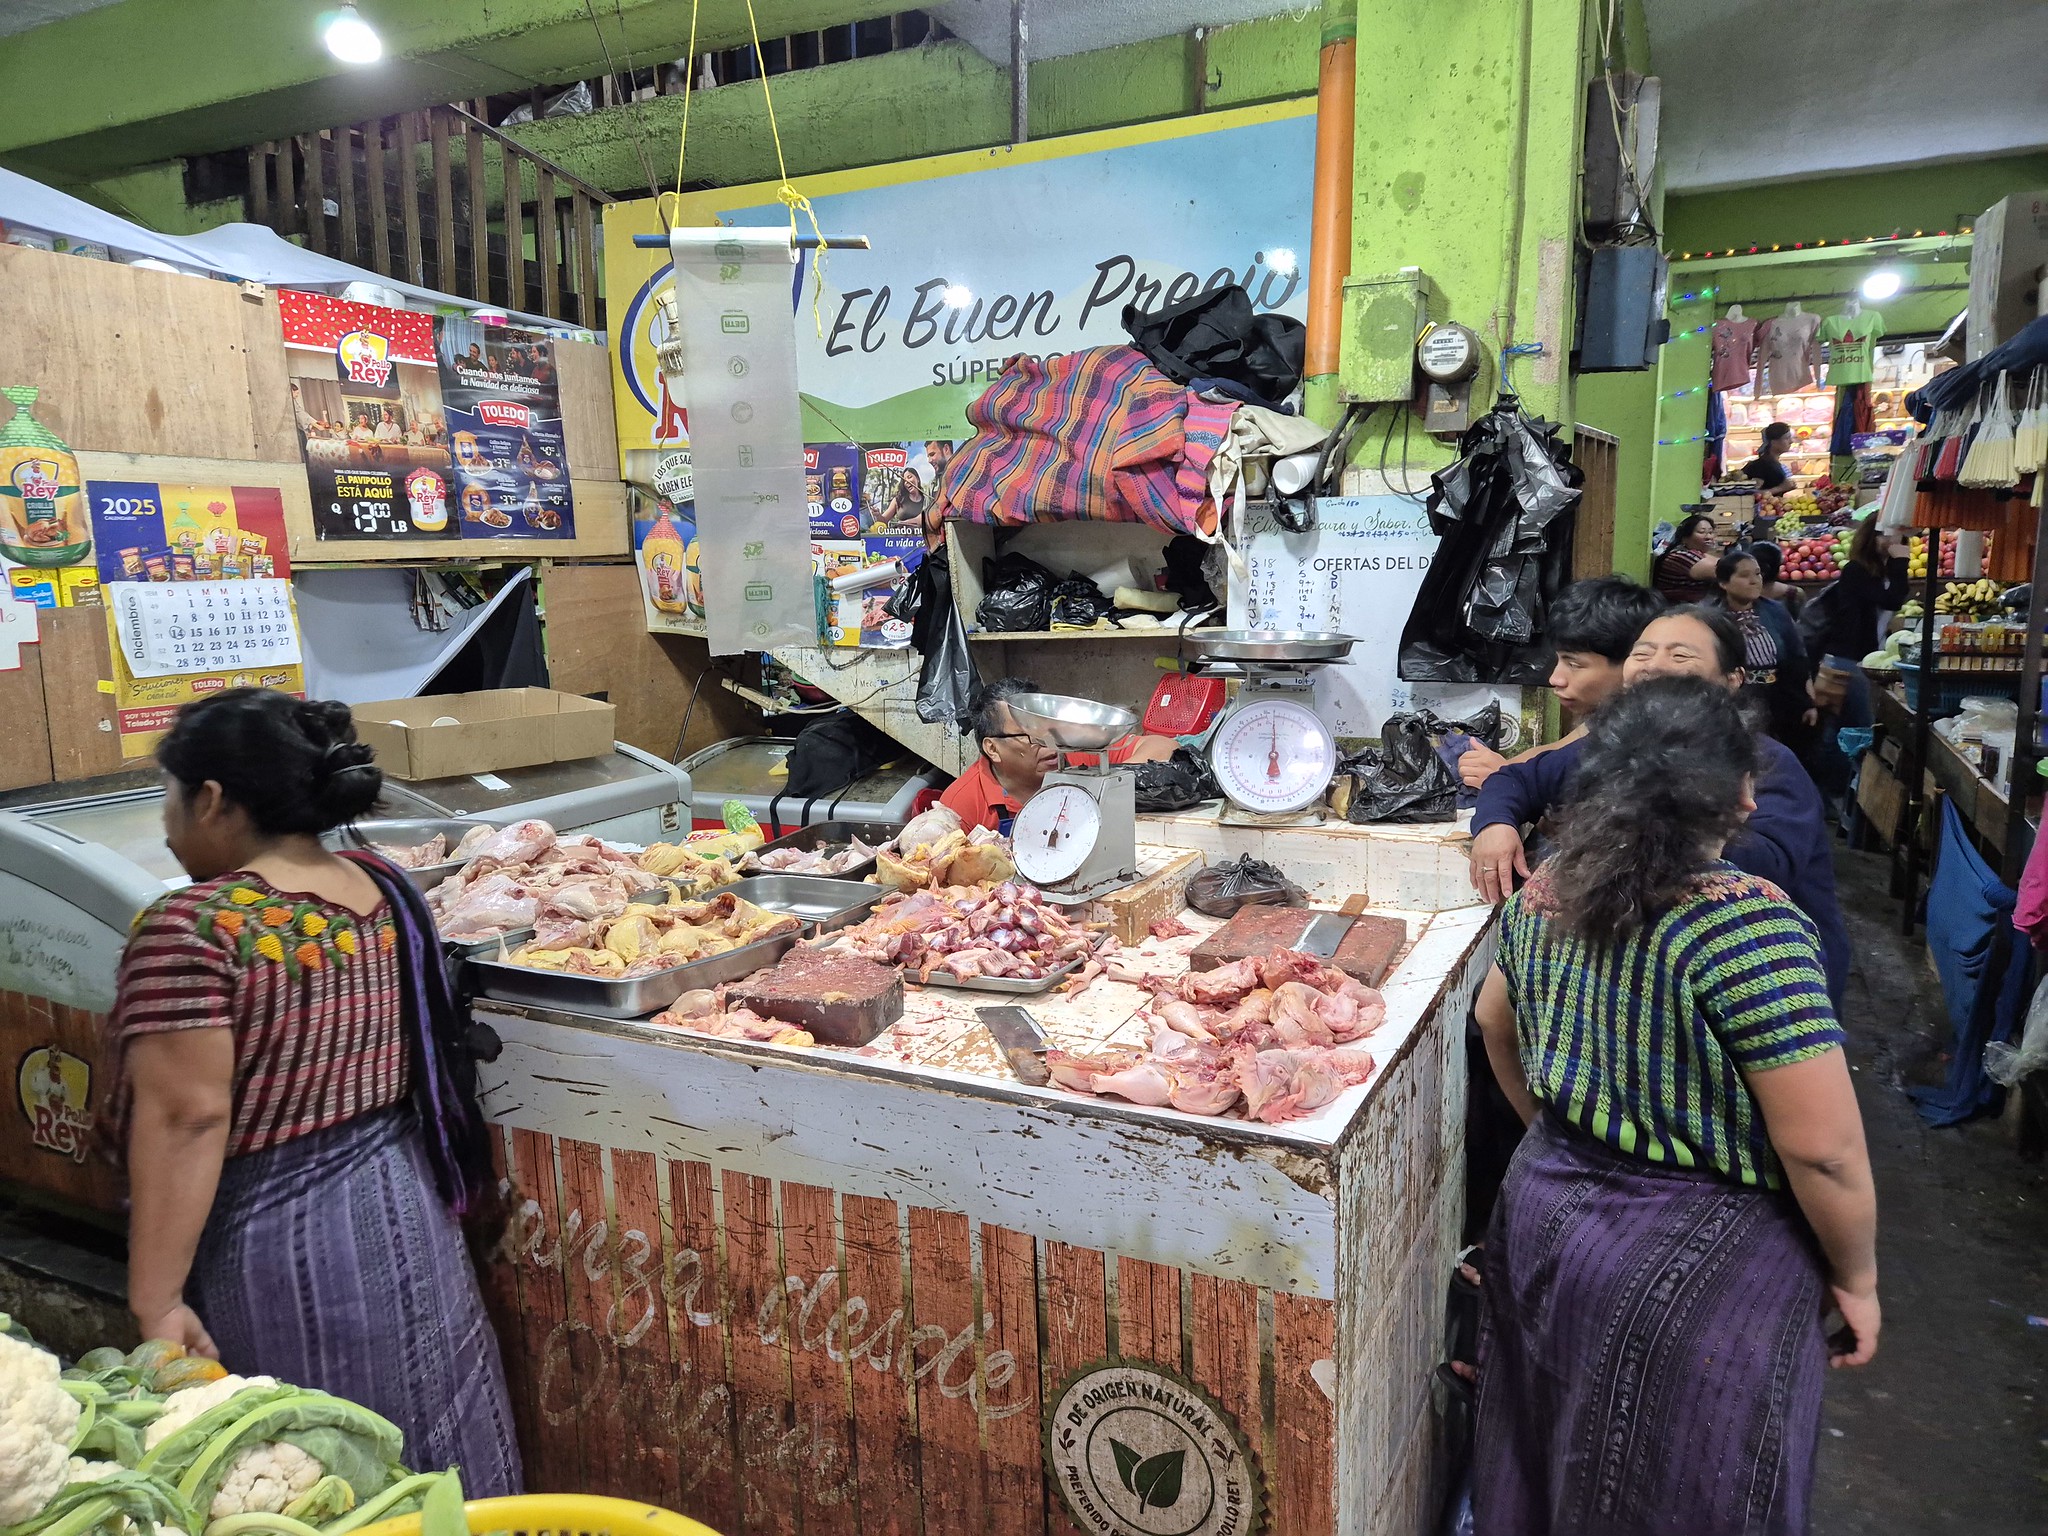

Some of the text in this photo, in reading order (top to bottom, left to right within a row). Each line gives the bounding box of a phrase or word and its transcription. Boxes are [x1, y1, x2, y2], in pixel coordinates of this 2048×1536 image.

[826, 284, 891, 358] El
[903, 277, 1061, 349] Buen
[371, 358, 391, 370] Pollo
[351, 360, 390, 386] Rey
[456, 365, 541, 386] Cuando nos juntamos,
[460, 376, 540, 395] la Navidad es deliciosa
[482, 404, 526, 421] TOLEDO
[868, 453, 904, 465] TOLEDO
[654, 454, 692, 480] LOS QUE SAB
[347, 475, 392, 486] PAVIPOLLO
[658, 475, 693, 495] SABEN ELE
[22, 483, 58, 500] Rey
[337, 485, 394, 499] ESTÁ AQUÍ!
[416, 492, 436, 504] Rey
[100, 497, 157, 516] 2025
[331, 502, 343, 514] Q
[391, 520, 408, 533] LB
[809, 520, 835, 528] ntamos,
[1253, 515, 1284, 537] Elig
[1364, 507, 1411, 531] Sabor.
[877, 525, 912, 536] Cuando
[885, 538, 894, 547] la
[895, 538, 914, 547] vida
[1313, 557, 1381, 571] OFERTAS
[1386, 556, 1414, 570] DEL
[656, 567, 671, 579] Rey
[167, 589, 174, 597] D
[189, 600, 193, 608] 1
[206, 599, 213, 607] 2
[241, 598, 248, 606] 4
[258, 597, 264, 605] 5
[274, 596, 280, 605] 6
[172, 615, 178, 623] 7
[192, 614, 198, 622] 8
[209, 613, 215, 622] 9
[224, 613, 235, 621] 10
[241, 612, 251, 620] 11
[258, 611, 269, 619] 12
[274, 610, 285, 618] 13
[128, 596, 145, 660] Diciembre
[171, 630, 184, 638] 14
[191, 629, 202, 637] 15
[208, 628, 220, 636] 16
[225, 627, 236, 635] 17
[243, 626, 254, 635] 18
[260, 625, 271, 633] 19
[276, 624, 287, 632] 20
[1264, 621, 1275, 630] 22
[174, 644, 185, 653] 21
[192, 643, 204, 652] 22
[210, 642, 222, 650] 23
[227, 641, 238, 650] 24
[245, 640, 256, 648] 25
[262, 639, 274, 647] 26
[279, 638, 289, 646] 27
[176, 659, 189, 668] 28
[194, 658, 206, 667] 29
[212, 656, 224, 665] 30
[230, 655, 241, 664] 31
[193, 680, 224, 690] TOLEDO
[125, 719, 155, 728] Toledo
[34, 1103, 89, 1163] Rey
[757, 1264, 1032, 1420] desde
[1067, 1381, 1215, 1439] DE ORIGEN NATURAL
[1065, 1465, 1110, 1532] PREFERIDO
[1226, 1480, 1239, 1505] REY
